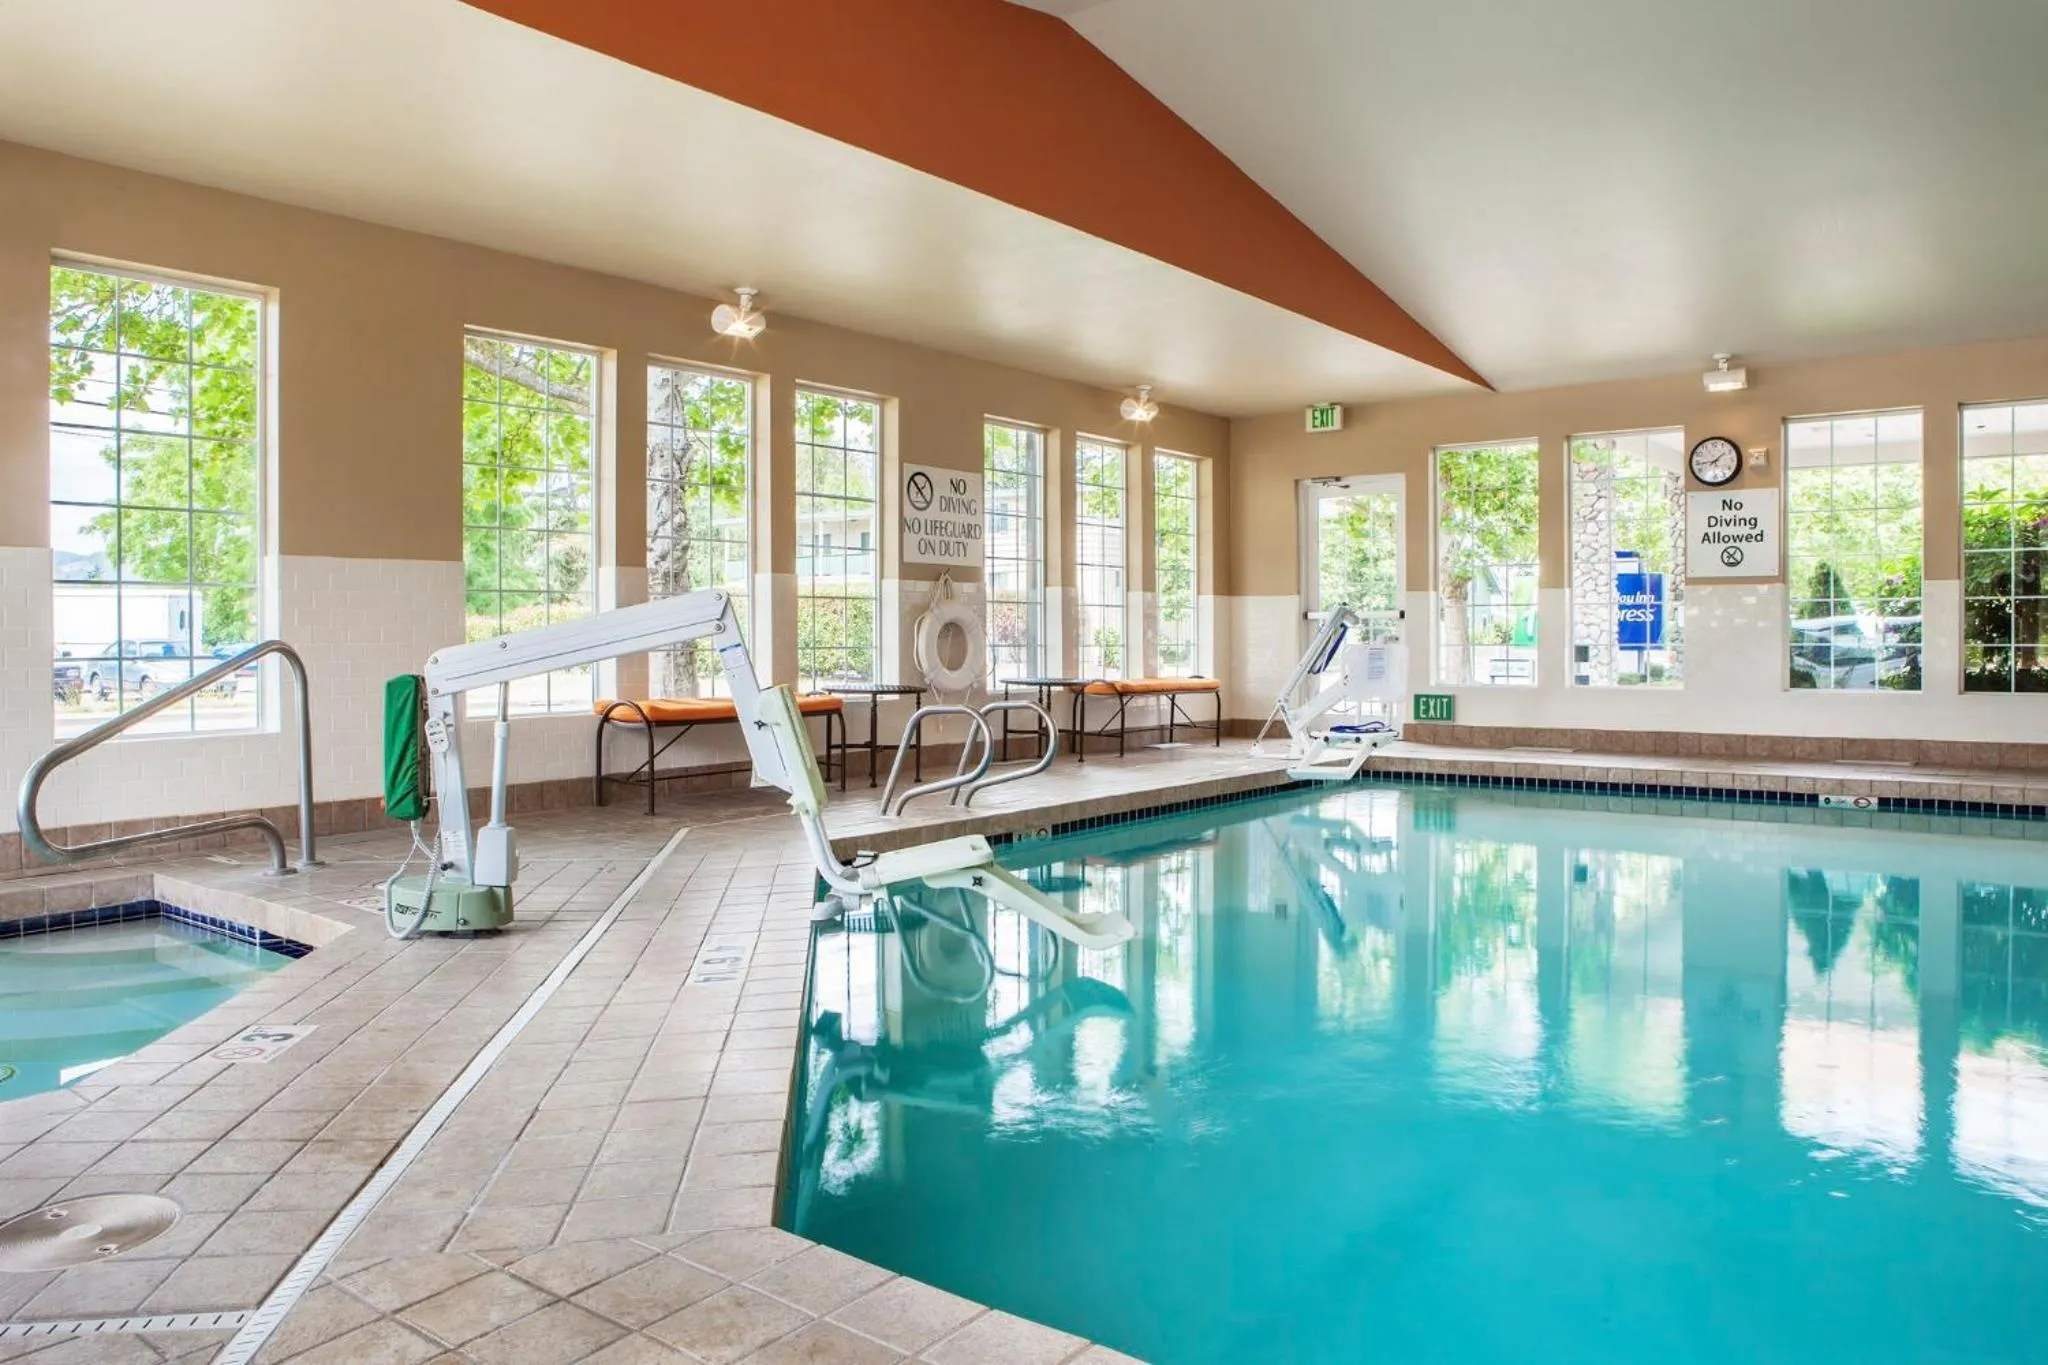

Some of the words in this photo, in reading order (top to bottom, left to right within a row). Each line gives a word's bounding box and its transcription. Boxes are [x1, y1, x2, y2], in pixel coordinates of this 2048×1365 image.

[1312, 407, 1336, 428] EXIT
[949, 478, 967, 496] NO
[940, 495, 977, 516] DIVING
[1721, 498, 1743, 512] No
[903, 516, 921, 535] NO
[924, 518, 983, 540] LIFEGUARD
[1707, 515, 1758, 529] Diving
[918, 537, 936, 556] ON
[940, 539, 969, 557] DUTY
[1701, 530, 1764, 544] Allowed
[1419, 697, 1449, 719] EXIT
